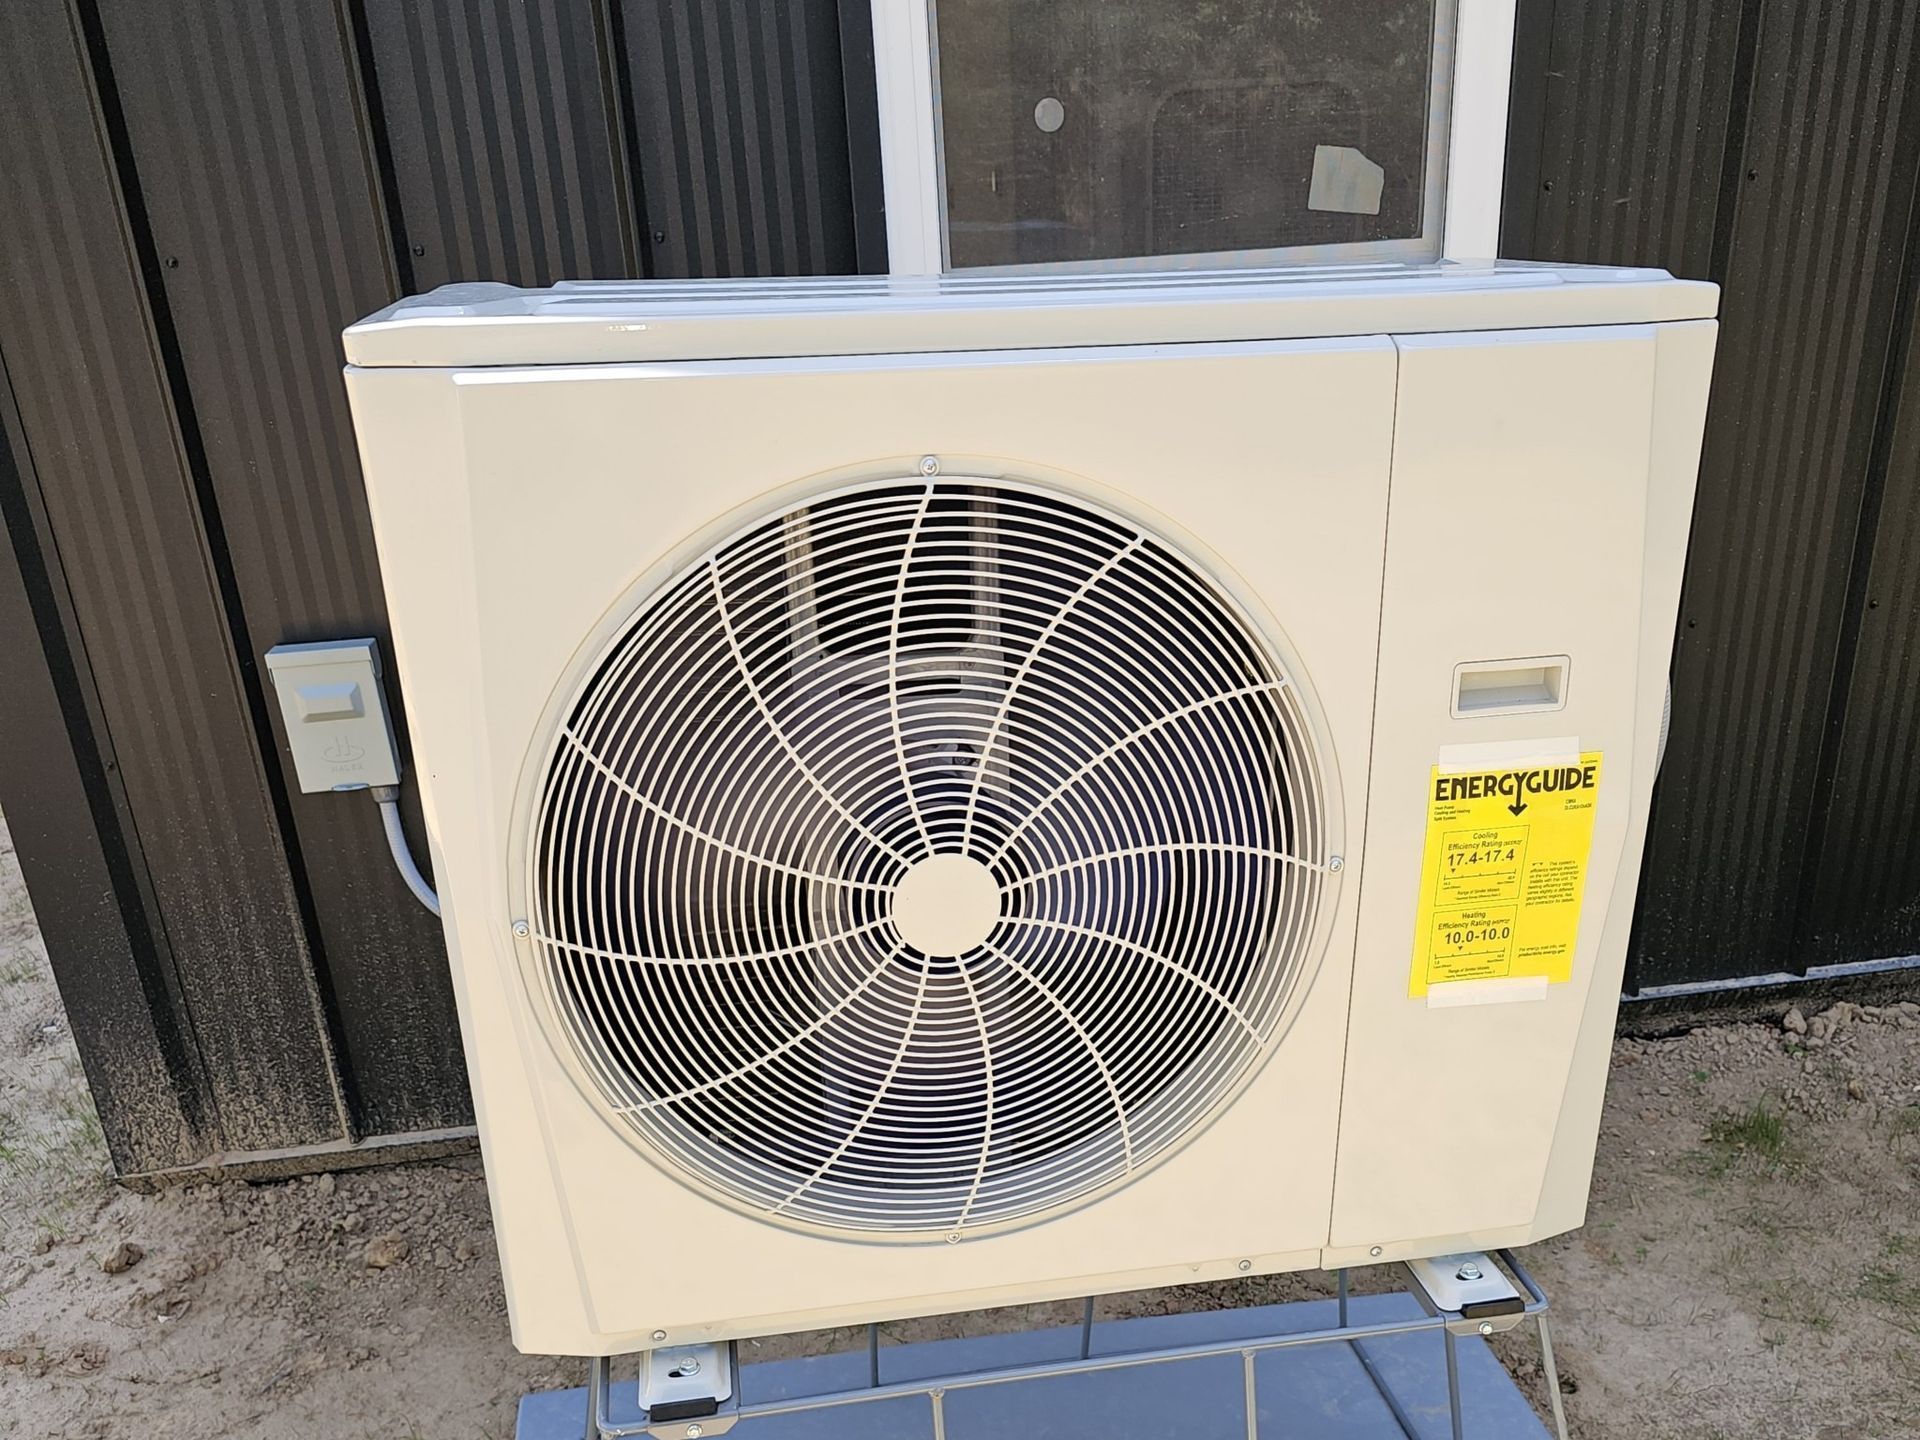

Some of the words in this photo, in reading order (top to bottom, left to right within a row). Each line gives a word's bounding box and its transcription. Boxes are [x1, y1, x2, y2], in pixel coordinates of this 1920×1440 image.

[1435, 766, 1596, 802] ENERGYGUIDE
[1448, 843, 1480, 851] Efficiency
[1482, 840, 1502, 848] Rating
[1448, 848, 1514, 866] 17.4-17.4
[1438, 922, 1468, 930] Efficiency
[1445, 927, 1510, 944] 10.0-10.0
